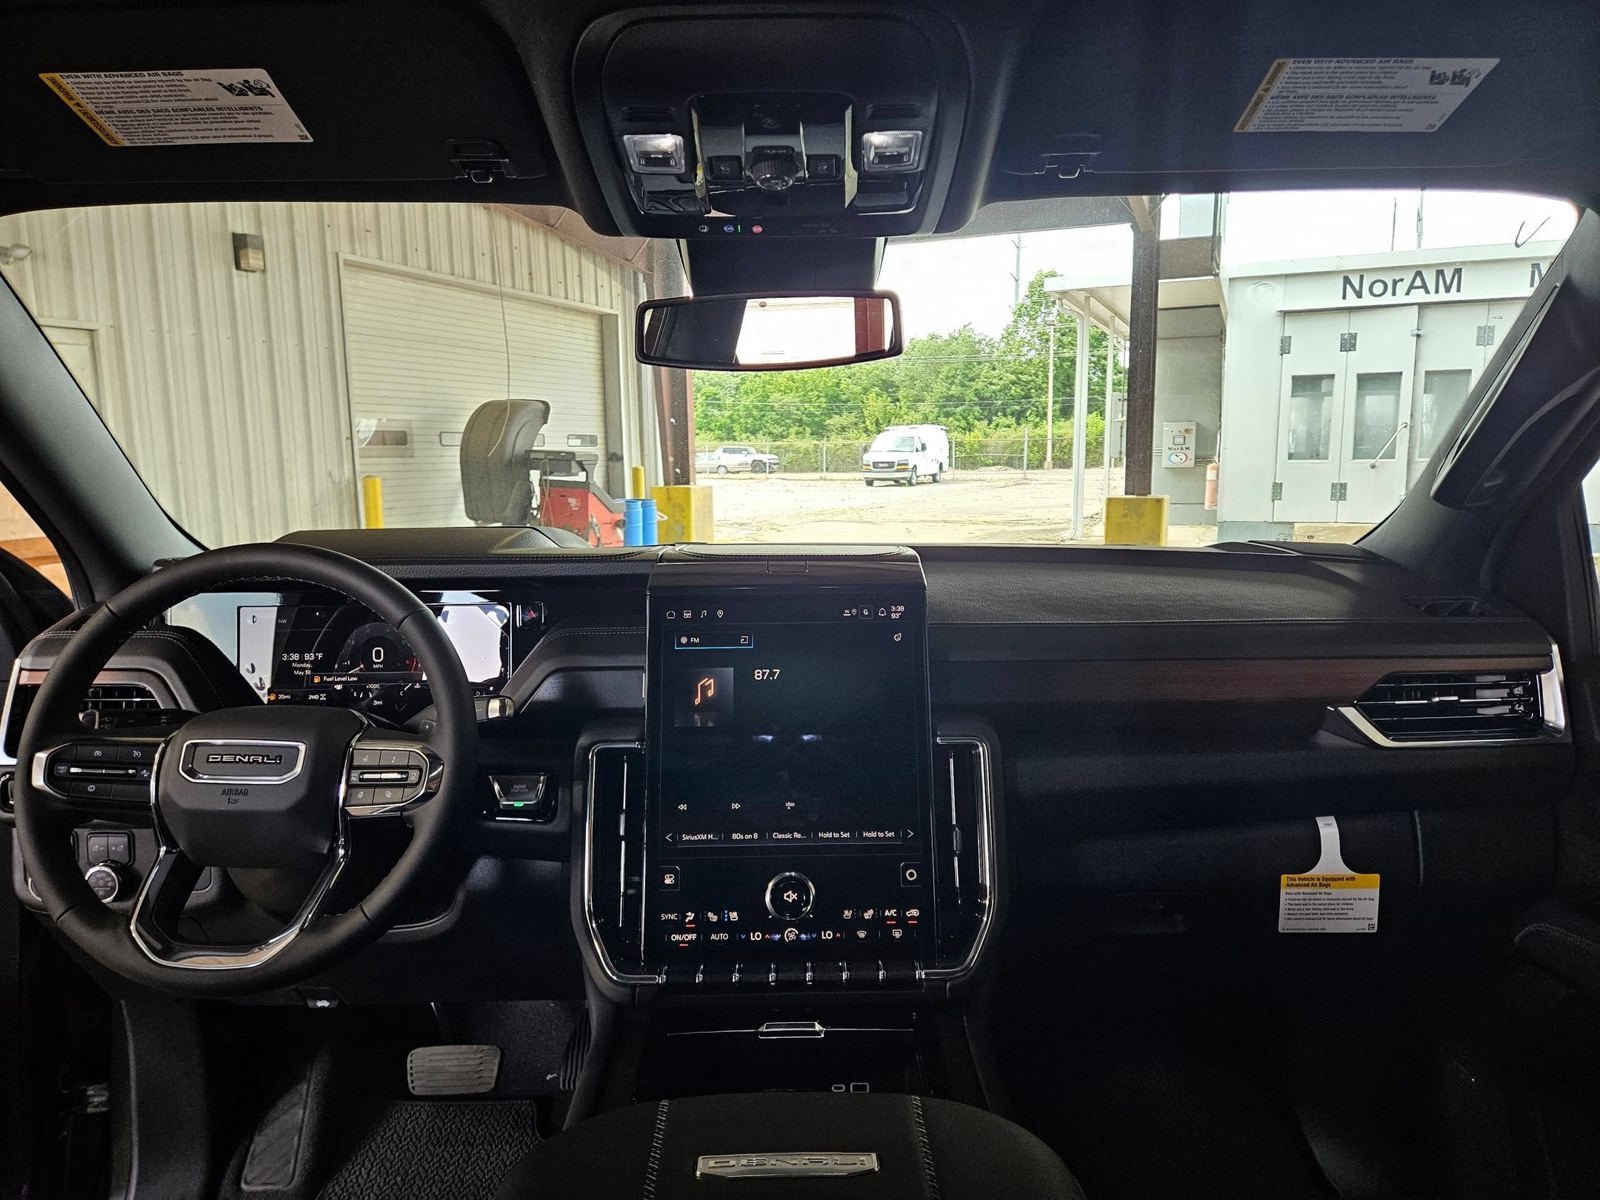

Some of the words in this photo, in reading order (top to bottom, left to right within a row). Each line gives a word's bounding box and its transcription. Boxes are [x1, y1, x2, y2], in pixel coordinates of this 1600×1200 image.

[1341, 267, 1463, 300] NorAM
[282, 653, 300, 661] 3:38
[372, 647, 384, 662] 0
[754, 669, 781, 681] 87.7
[207, 754, 283, 764] DENALI
[221, 788, 249, 796] AIRBAG
[682, 833, 707, 841] SiriusXM
[660, 913, 678, 921] SYNC
[670, 933, 697, 941] ON/OFF
[750, 931, 762, 941] LO
[821, 930, 833, 940] LO
